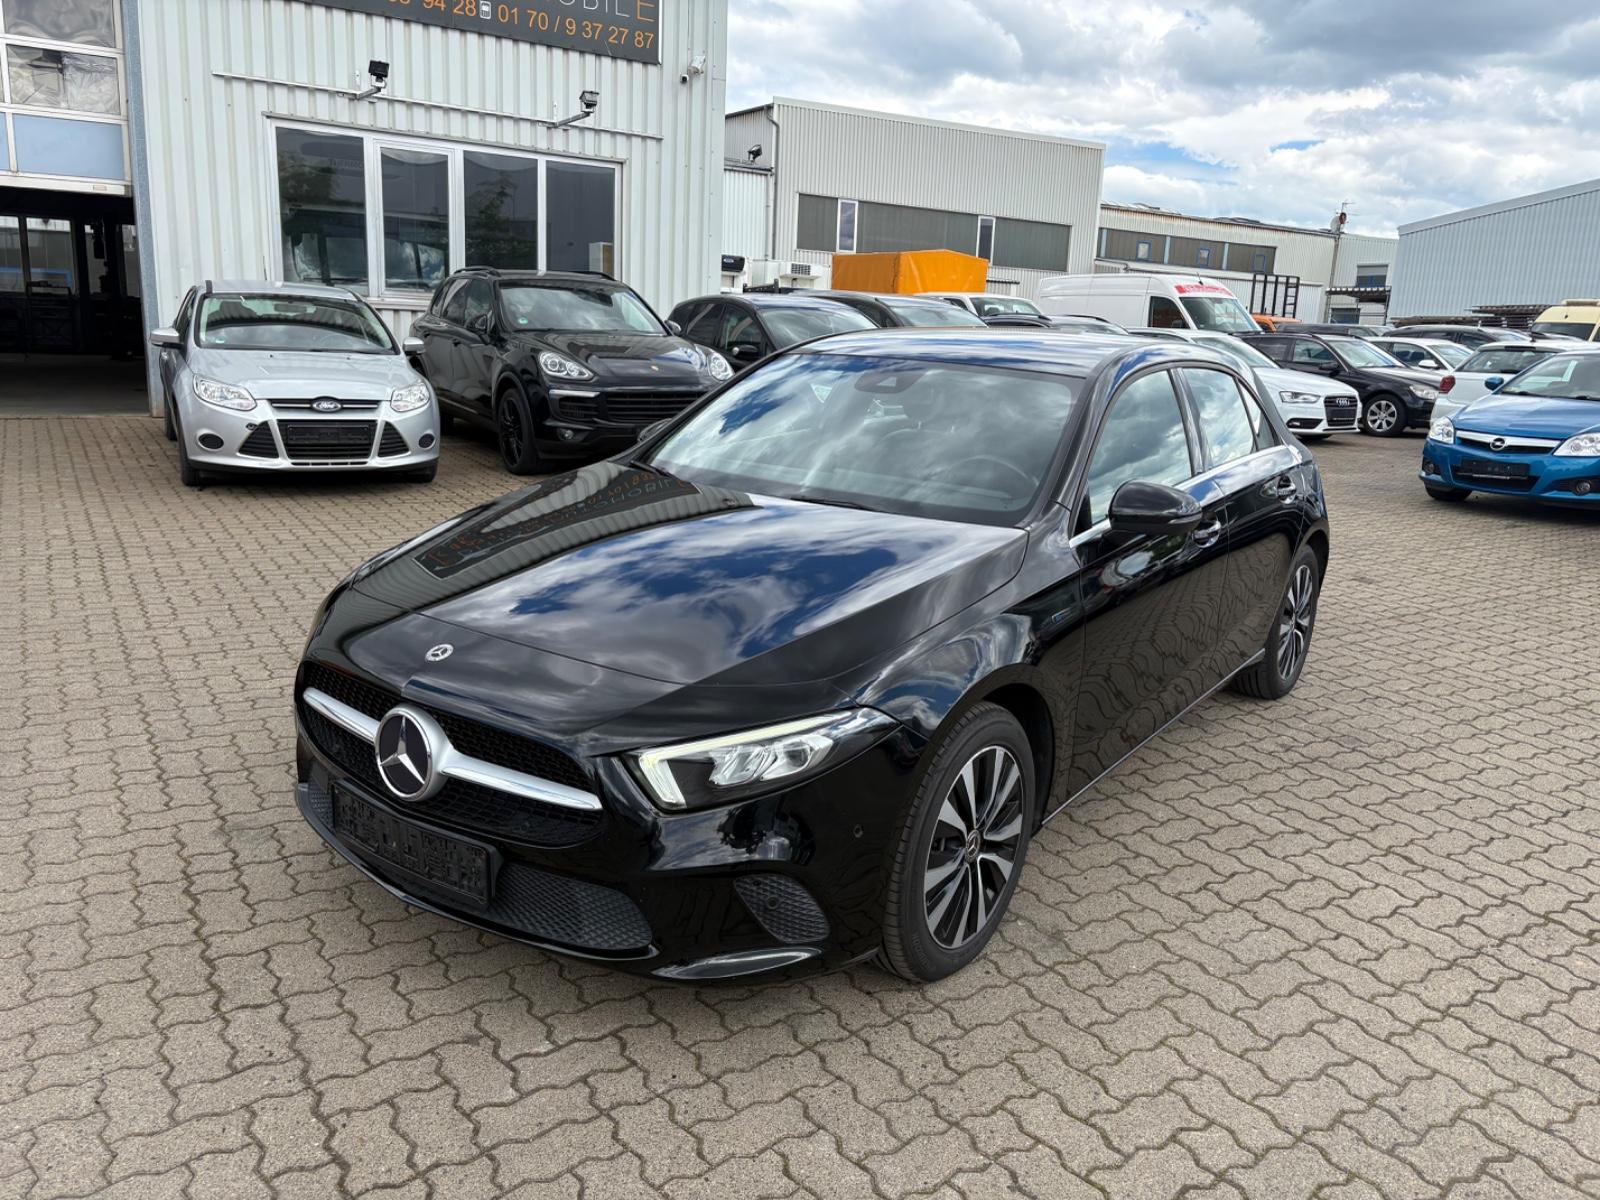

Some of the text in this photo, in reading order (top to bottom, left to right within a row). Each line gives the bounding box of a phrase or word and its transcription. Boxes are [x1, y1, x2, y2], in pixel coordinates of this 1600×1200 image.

[453, 0, 477, 16] 28
[498, 4, 518, 25] 01
[527, 10, 549, 31] 70
[554, 15, 560, 33] /
[565, 18, 576, 36] 9
[582, 21, 603, 40] 37
[608, 26, 629, 45] 27
[634, 30, 655, 49] 87
